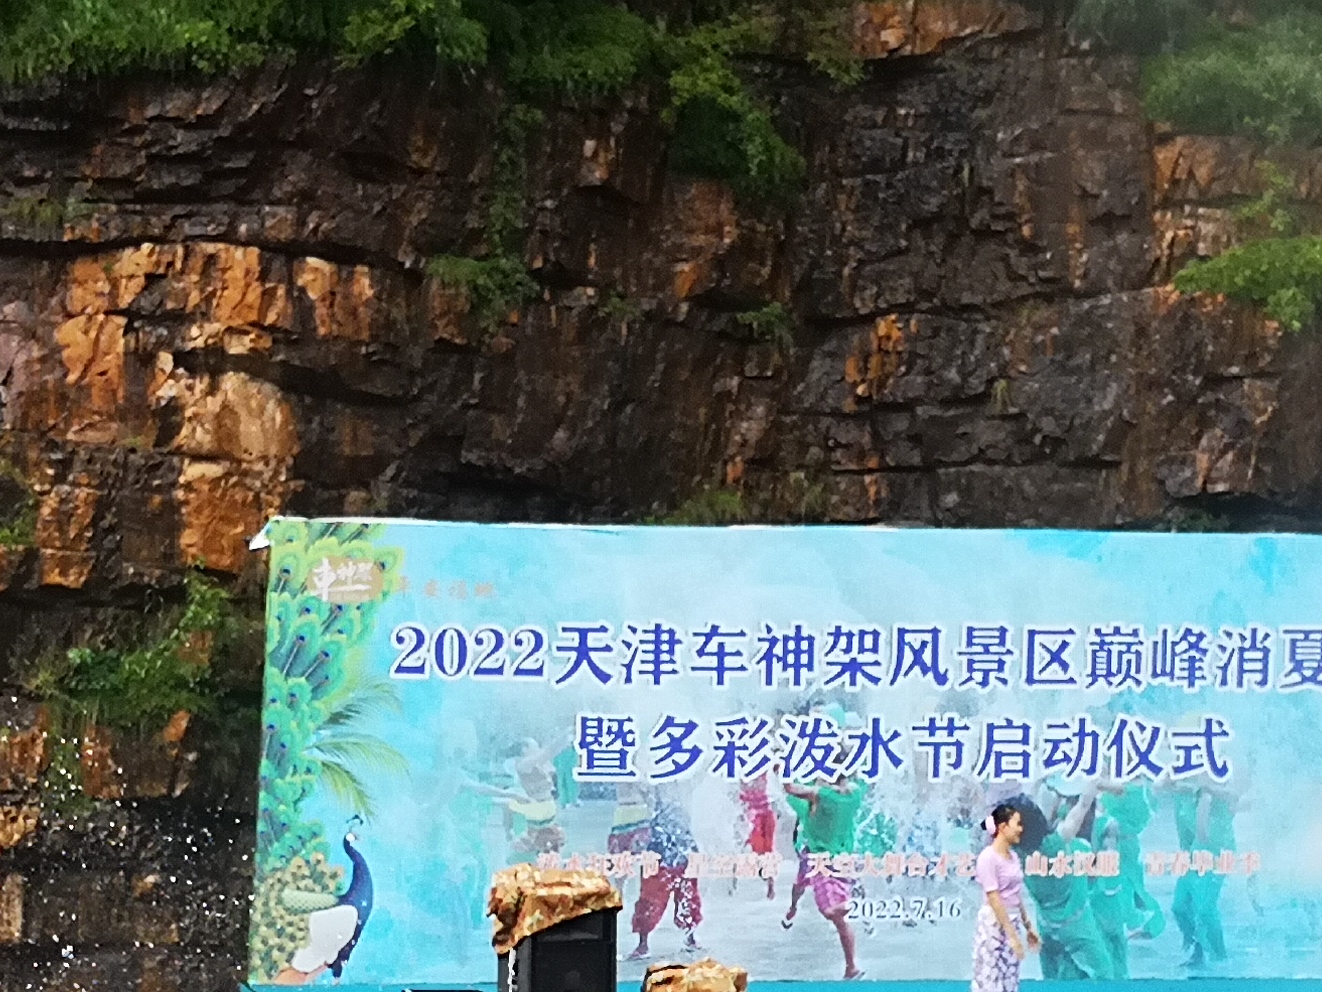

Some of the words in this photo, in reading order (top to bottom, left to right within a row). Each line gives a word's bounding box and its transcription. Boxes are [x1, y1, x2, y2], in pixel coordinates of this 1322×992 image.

[577, 715, 1230, 779] 暨多彩泼水节启动仪式
[848, 901, 961, 920] 2022.7.16
